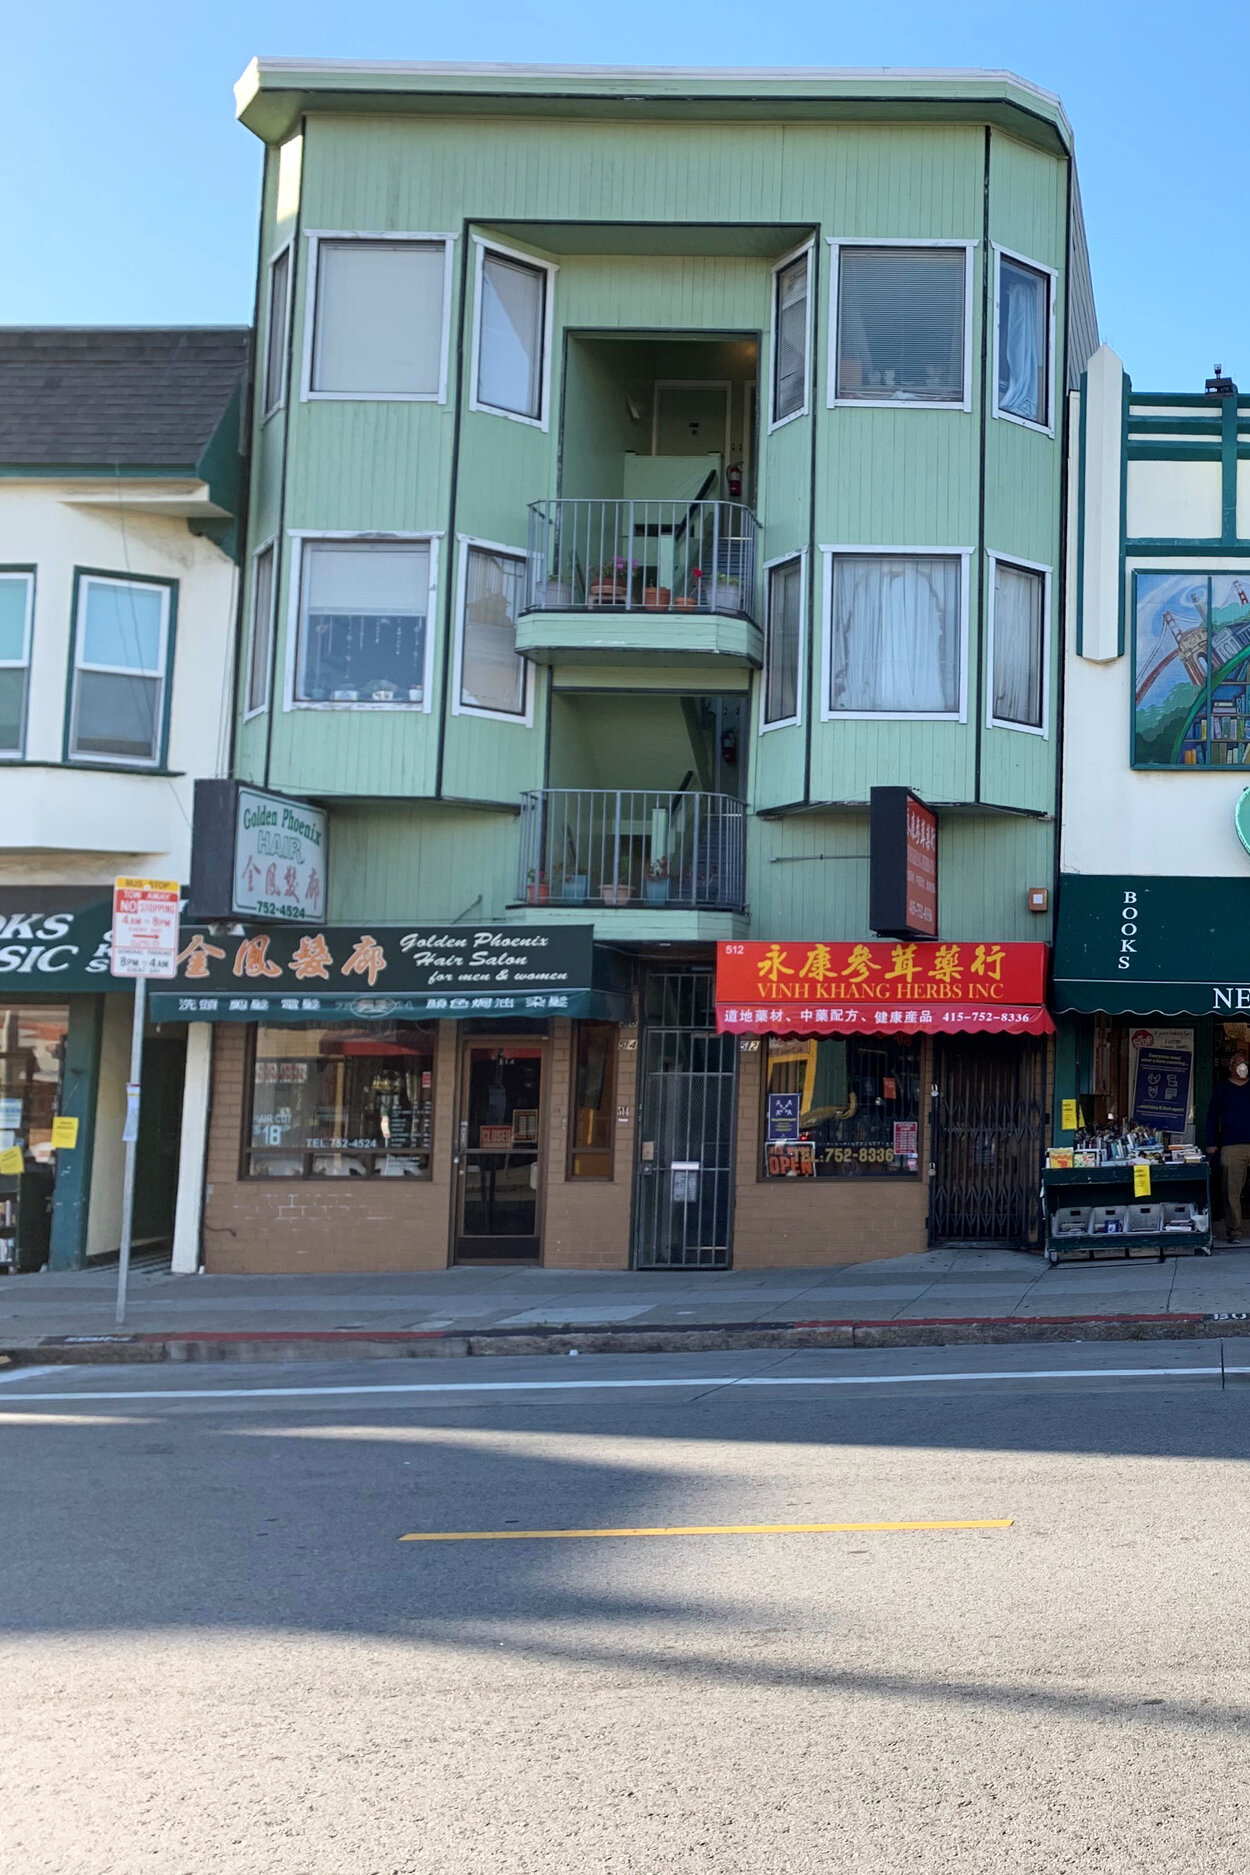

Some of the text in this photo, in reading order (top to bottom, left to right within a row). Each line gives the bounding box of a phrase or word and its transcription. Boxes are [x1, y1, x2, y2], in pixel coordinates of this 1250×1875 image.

[243, 804, 322, 846] Golden Phoenix
[257, 830, 305, 865] HAIR
[149, 881, 171, 889] STOP
[120, 900, 175, 914] NO STOPPING
[257, 901, 305, 919] 752-4524
[0, 913, 75, 940] KS
[1117, 890, 1139, 971] BOOKS
[400, 932, 549, 952] Golden Phoenix
[725, 945, 744, 955] 512
[413, 951, 528, 967] Hair Salon
[428, 969, 569, 985] for men & women
[757, 983, 1004, 999] VINH KHANG HERBS INC
[942, 1011, 1030, 1023] 415-752-8336
[618, 1039, 638, 1050] 514
[740, 1040, 760, 1051] 512
[768, 1156, 814, 1174] OPEN
